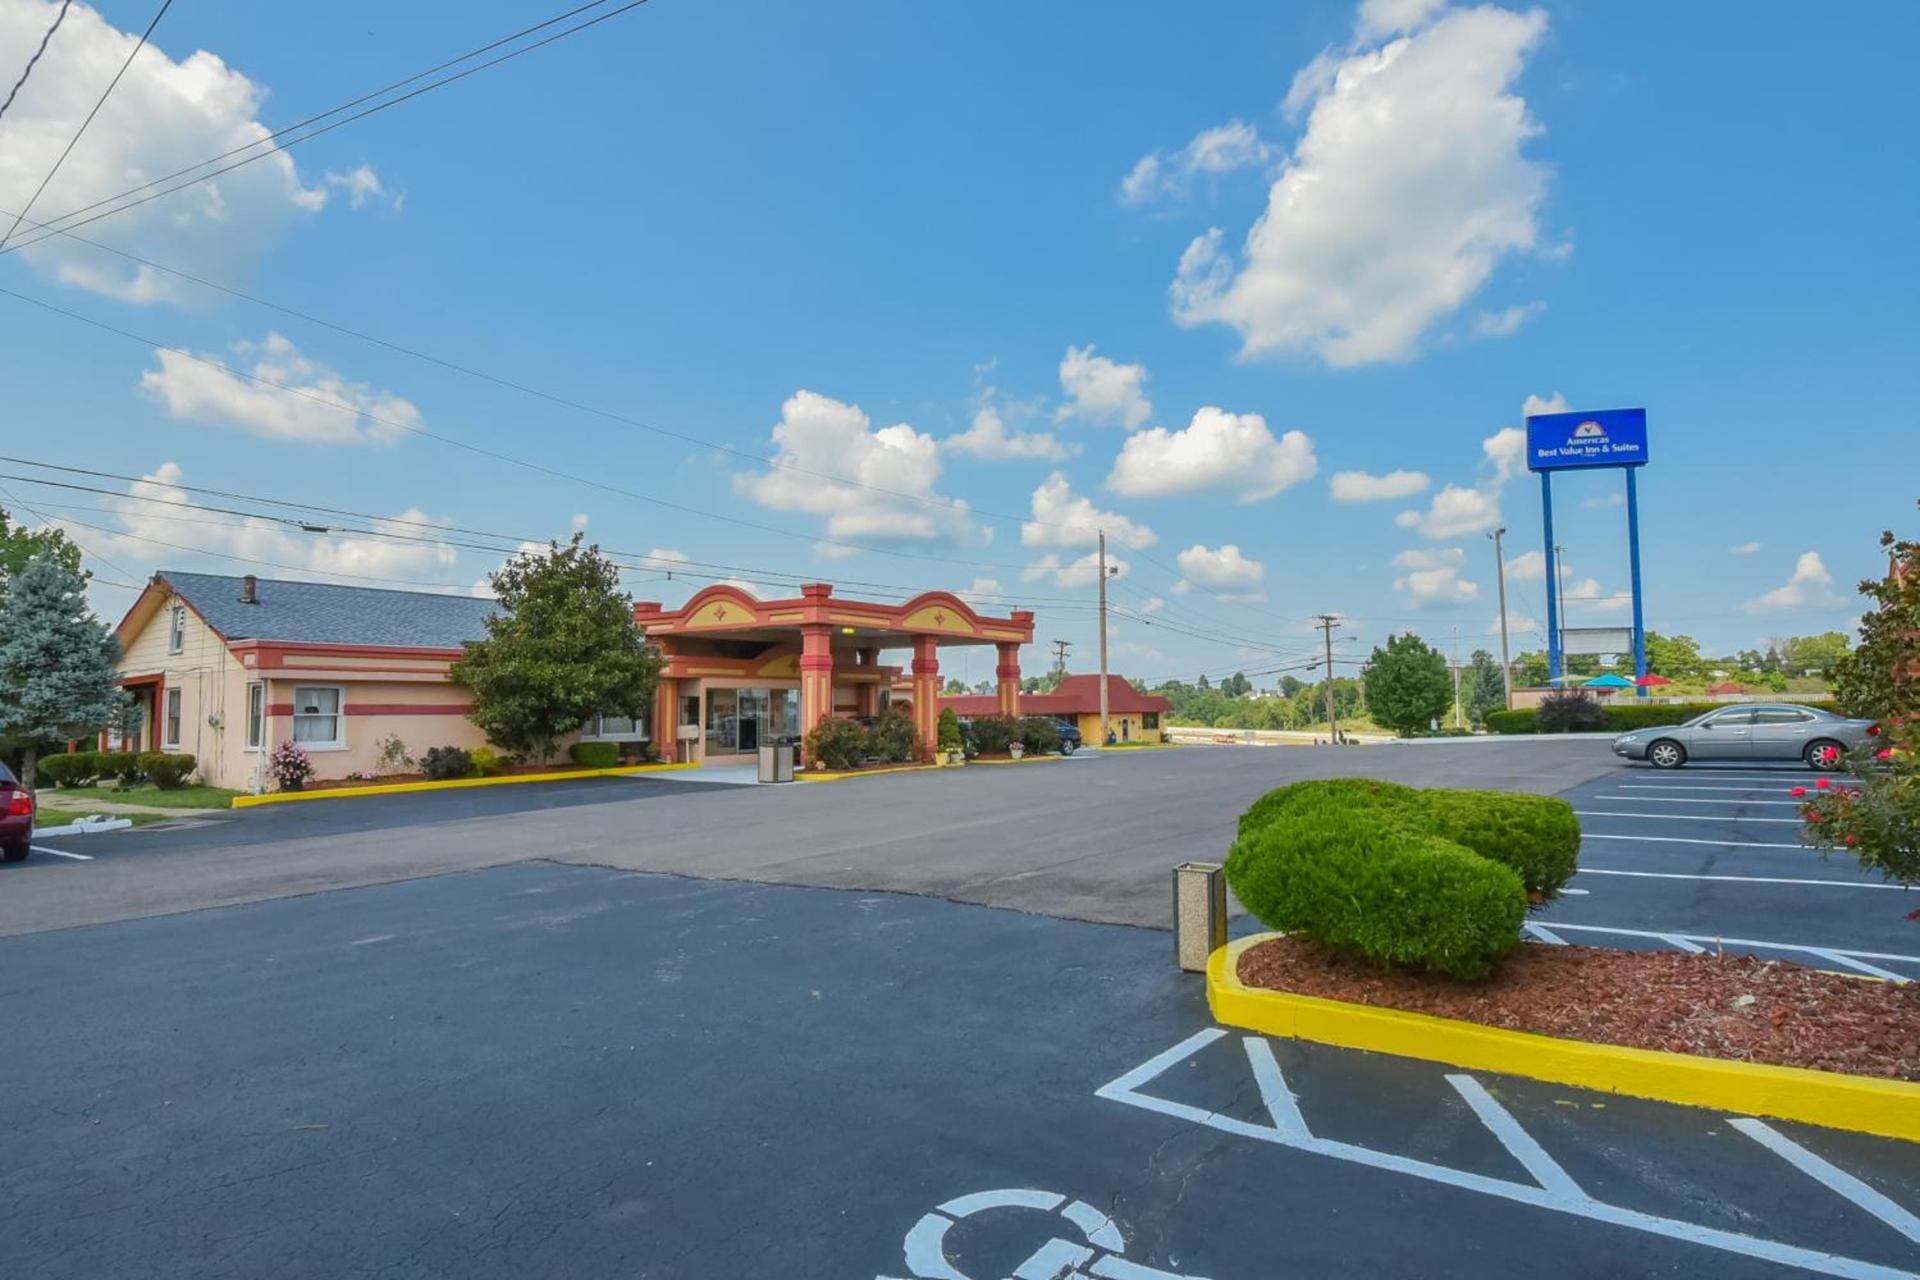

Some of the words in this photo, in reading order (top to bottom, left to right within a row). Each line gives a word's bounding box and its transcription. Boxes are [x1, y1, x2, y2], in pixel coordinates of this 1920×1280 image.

[1566, 436, 1610, 446] Americas
[1538, 449, 1557, 457] Best
[1559, 446, 1584, 456] Value
[1585, 446, 1600, 454] Inn
[1602, 445, 1610, 453] &
[1612, 442, 1639, 452] Suites
